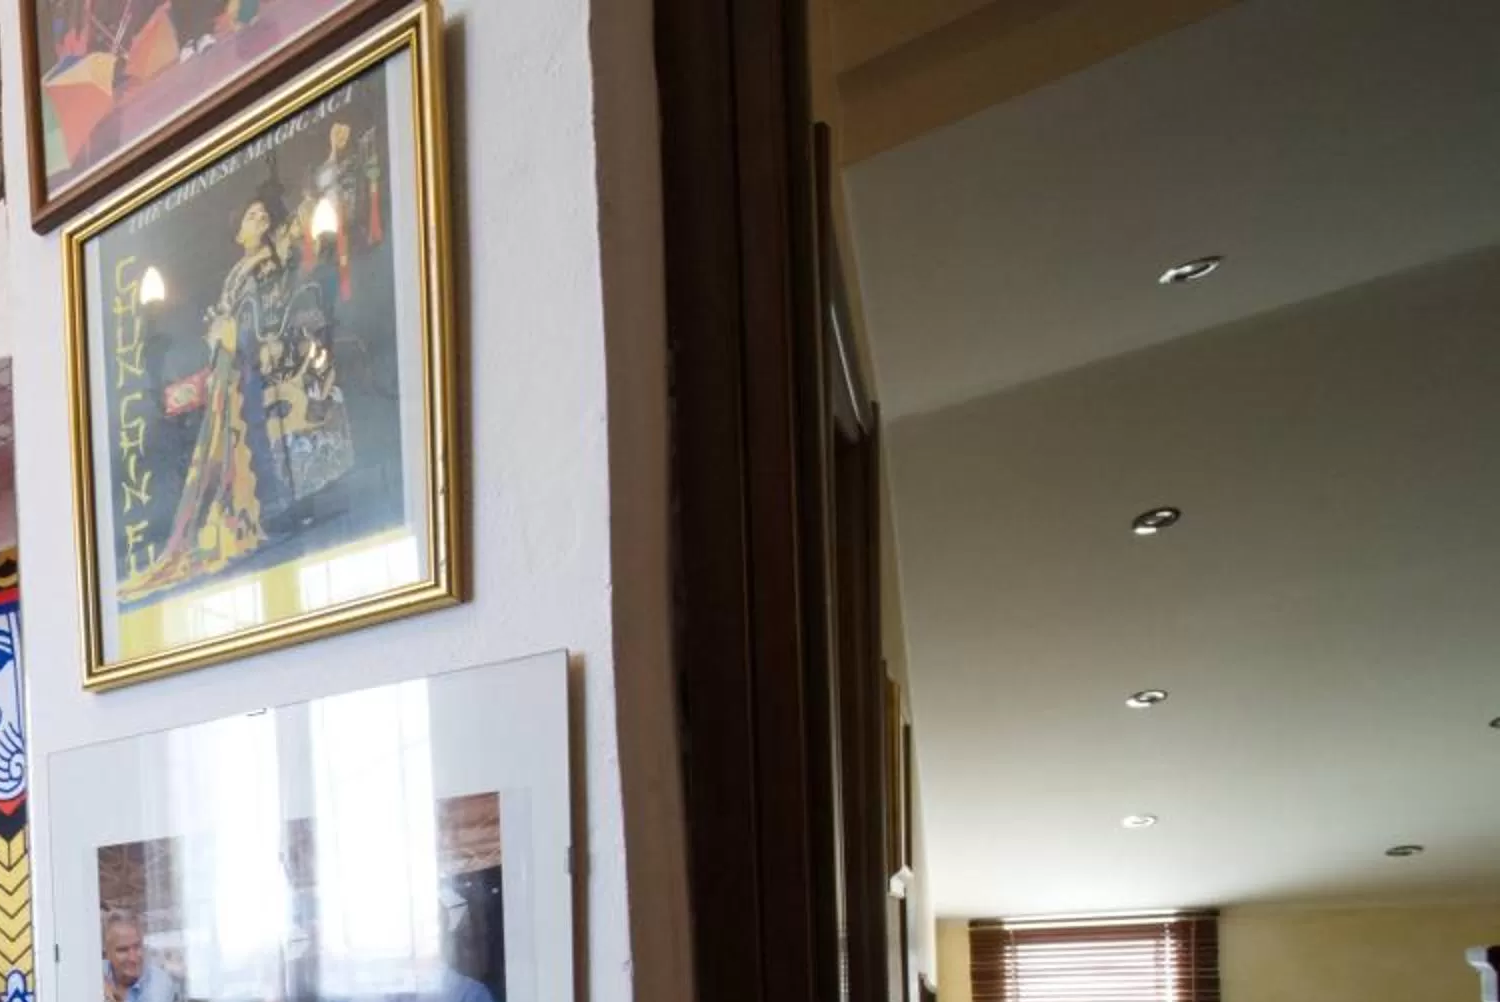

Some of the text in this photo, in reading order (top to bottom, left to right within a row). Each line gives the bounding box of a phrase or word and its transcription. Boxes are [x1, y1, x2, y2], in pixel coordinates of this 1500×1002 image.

[128, 82, 356, 234] THE CHINESE MAGIC ACT
